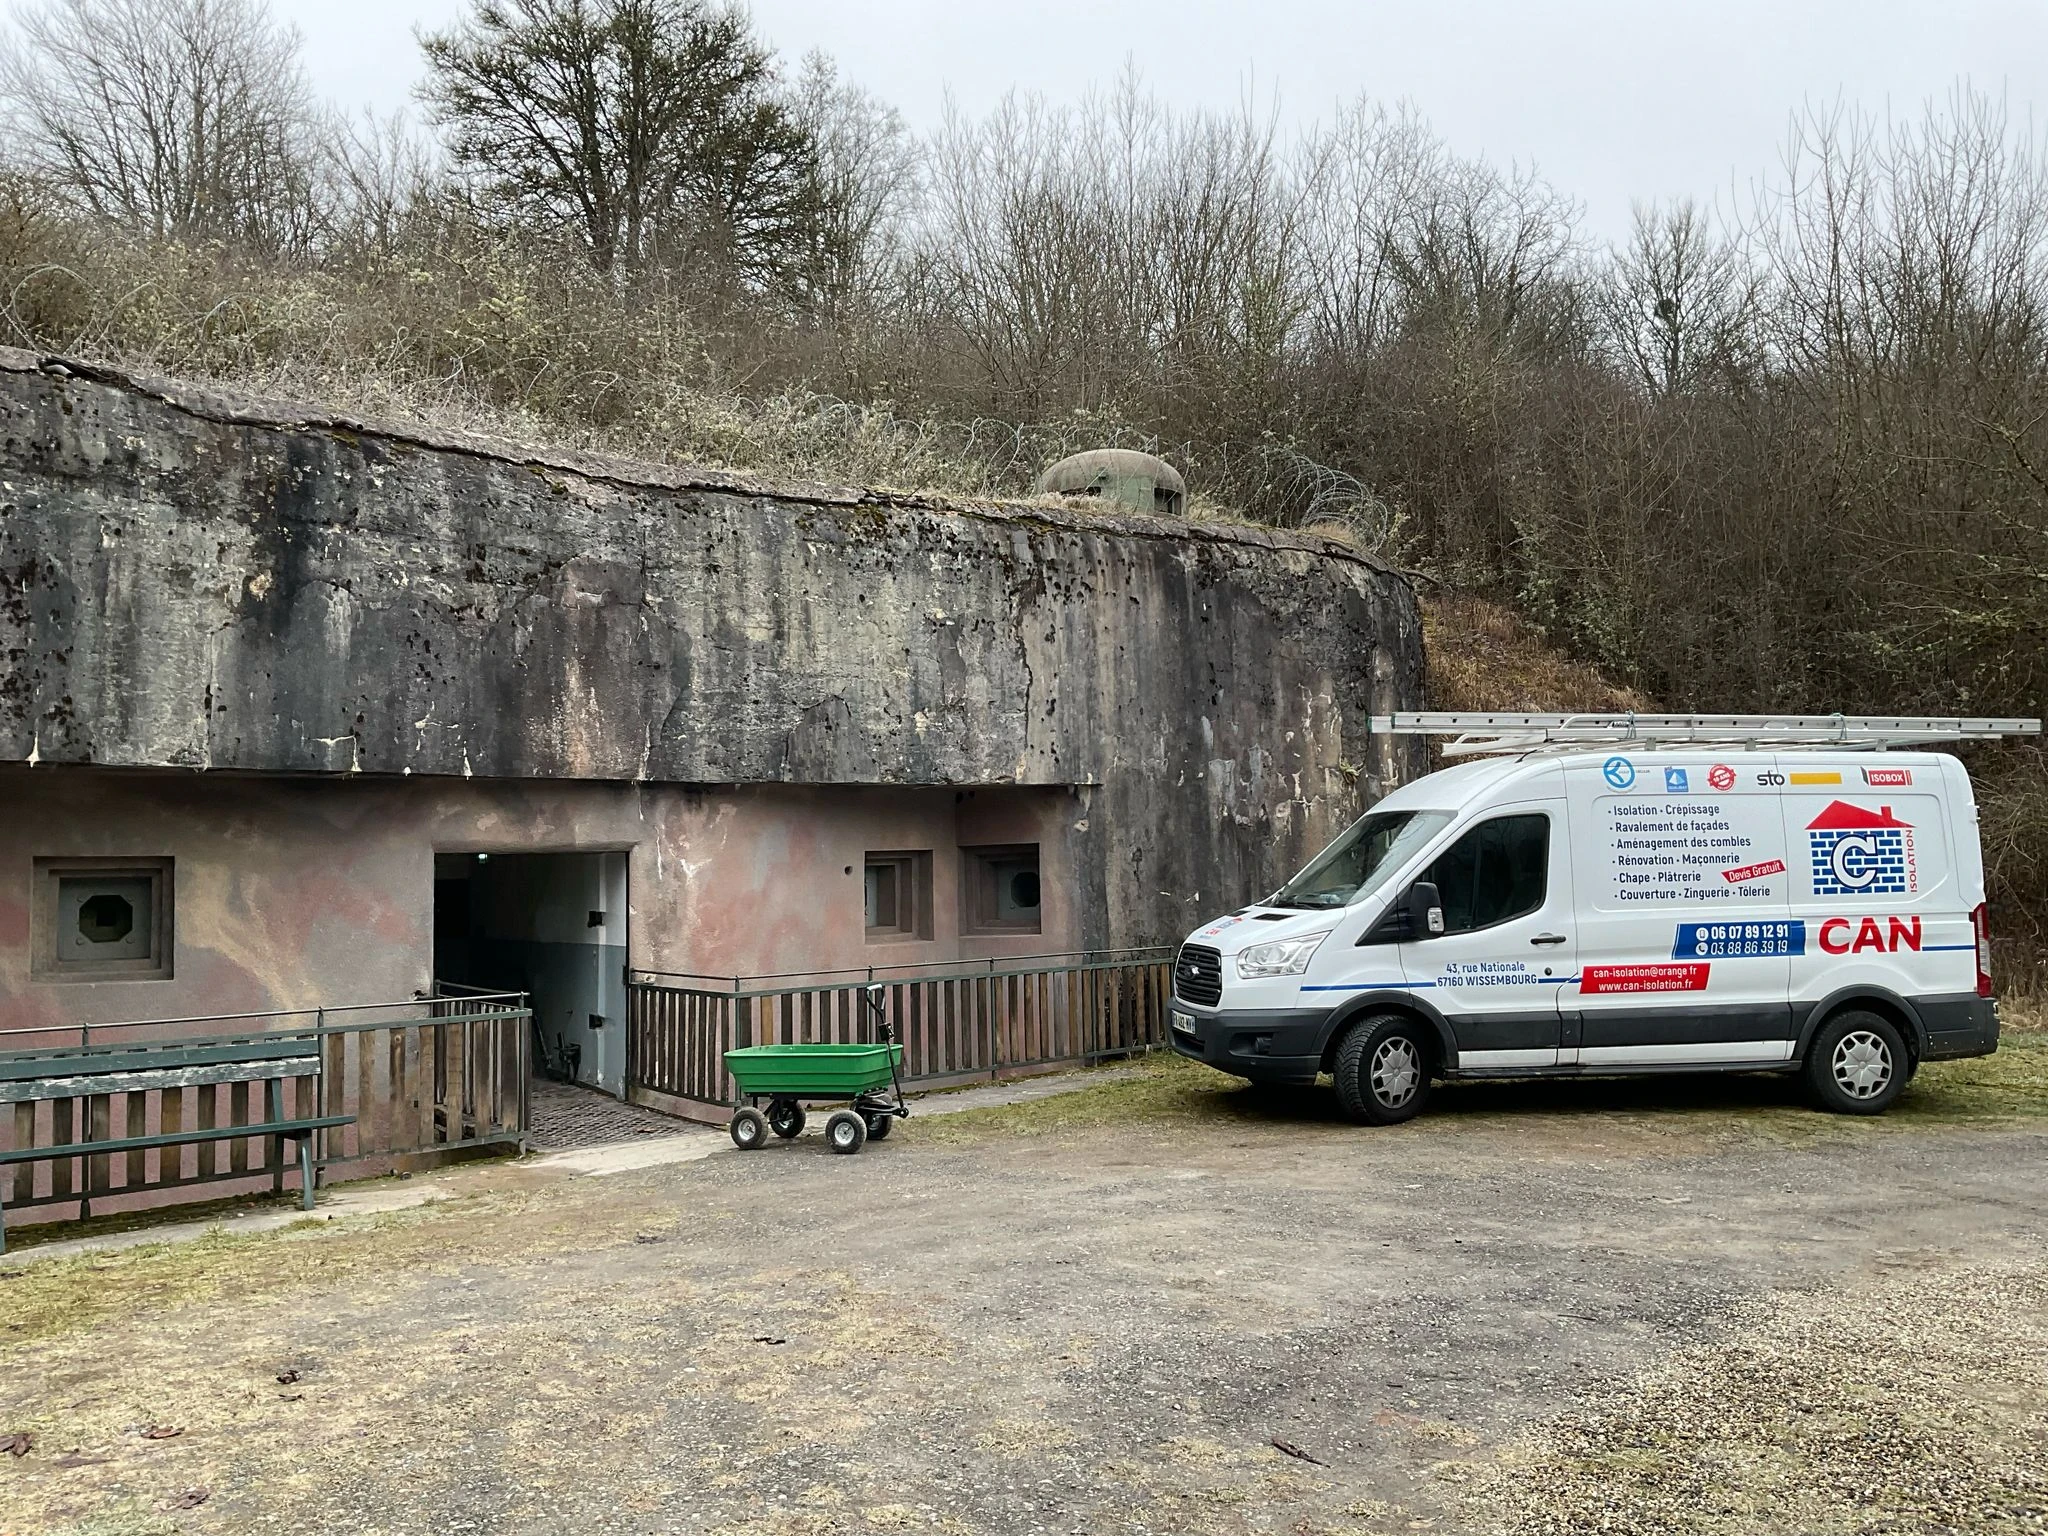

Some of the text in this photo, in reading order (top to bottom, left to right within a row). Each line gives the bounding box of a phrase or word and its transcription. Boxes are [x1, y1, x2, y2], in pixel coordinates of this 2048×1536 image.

[1757, 770, 1785, 786] sto
[1871, 774, 1904, 783] ISOBOX
[1614, 803, 1720, 816] Isolation Crépissage
[1615, 820, 1730, 833] Ravalement de façades
[1617, 836, 1751, 850] Aménagement des combles
[1618, 852, 1740, 867] Rénovation Maçonnerie
[1906, 829, 1918, 893] ISOLATION
[1619, 870, 1701, 885] Chape Plâtrerie
[1728, 861, 1782, 882] Devis Gratuit
[1620, 889, 1676, 900] Couverture
[1684, 887, 1730, 900] Zinguerie
[1711, 924, 1789, 940] 06 07 89 12 91
[1818, 915, 1922, 955] CAN
[1710, 939, 1788, 955] 03 88 86 39 19
[1446, 961, 1525, 975] 43, rue Nationale
[1437, 974, 1537, 987] 67160 WISSEMBOURG
[1598, 980, 1693, 992] www.can-isolation.fr
